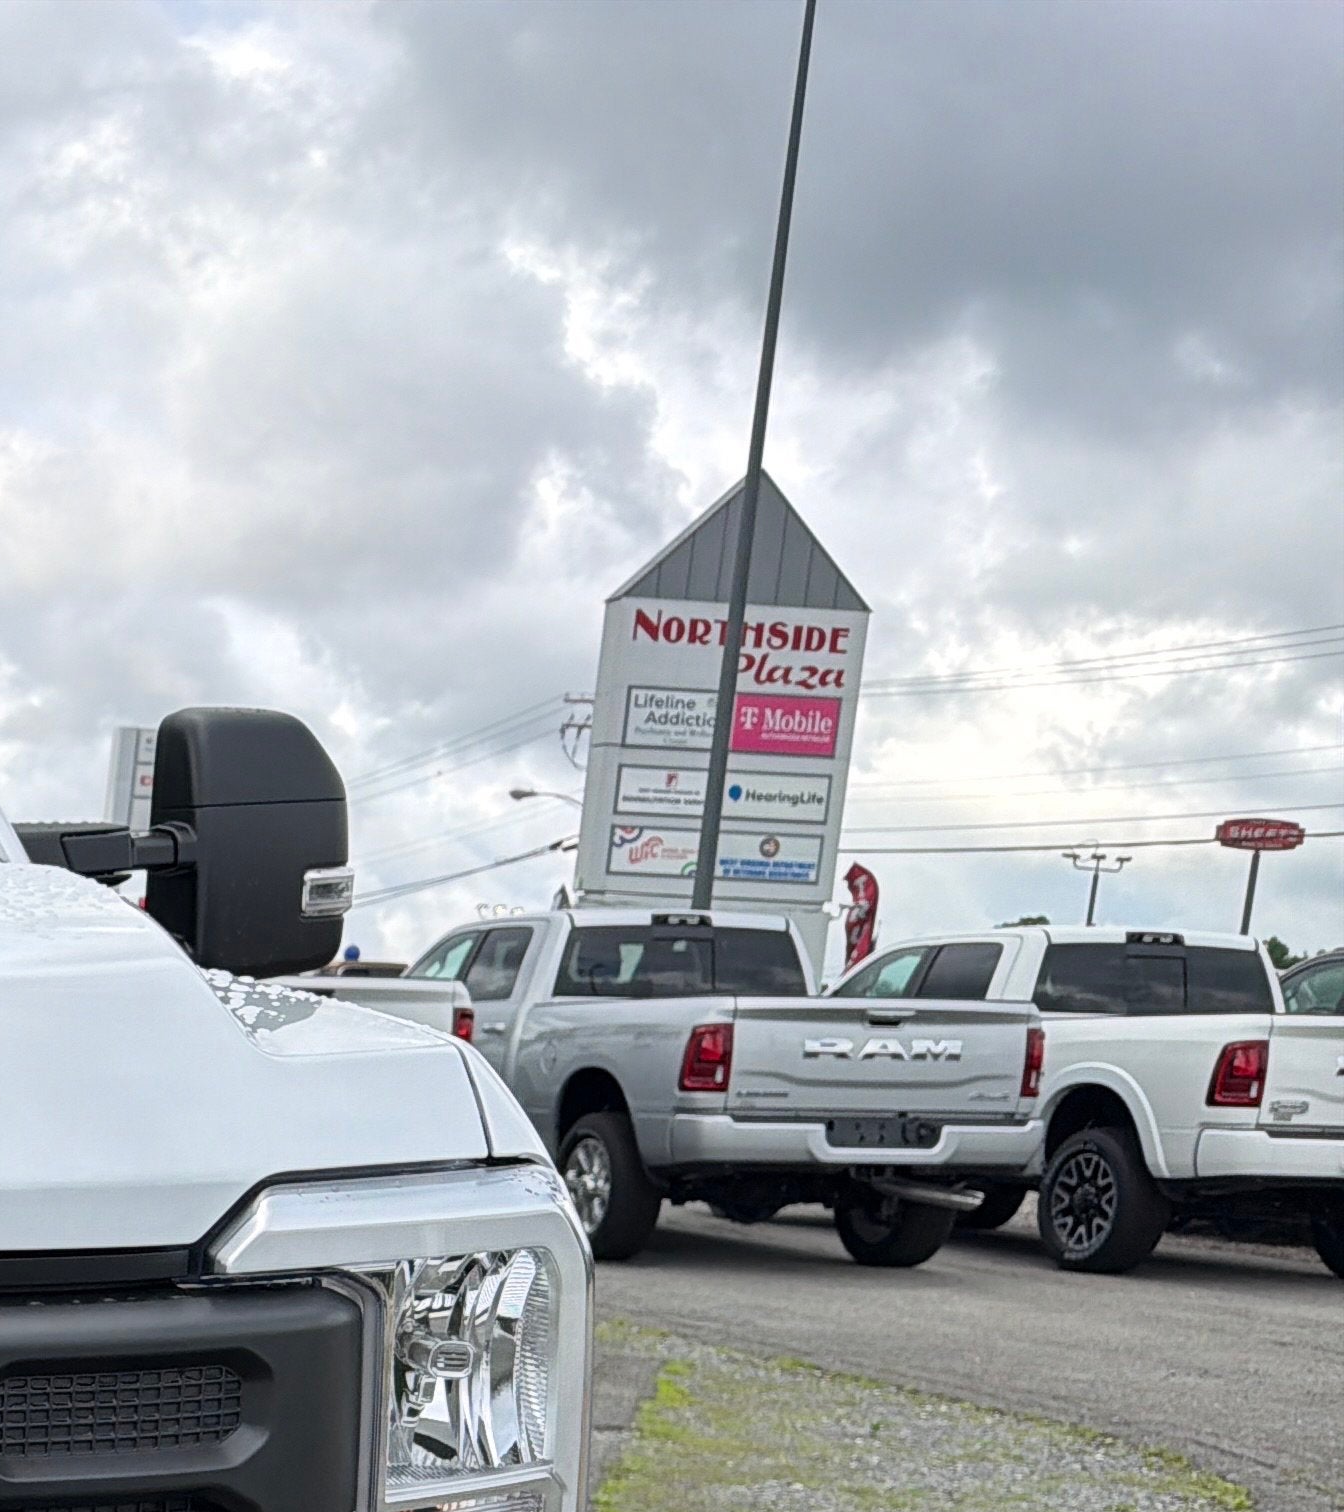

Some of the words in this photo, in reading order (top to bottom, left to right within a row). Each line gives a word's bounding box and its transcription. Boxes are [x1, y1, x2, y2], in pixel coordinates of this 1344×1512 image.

[632, 608, 850, 655] NORTHSIDE
[633, 693, 696, 711] Lifeline
[644, 710, 716, 728] Addictio
[762, 706, 833, 735] Mobile
[744, 788, 825, 807] HearingLife
[802, 1036, 963, 1061] RAM
